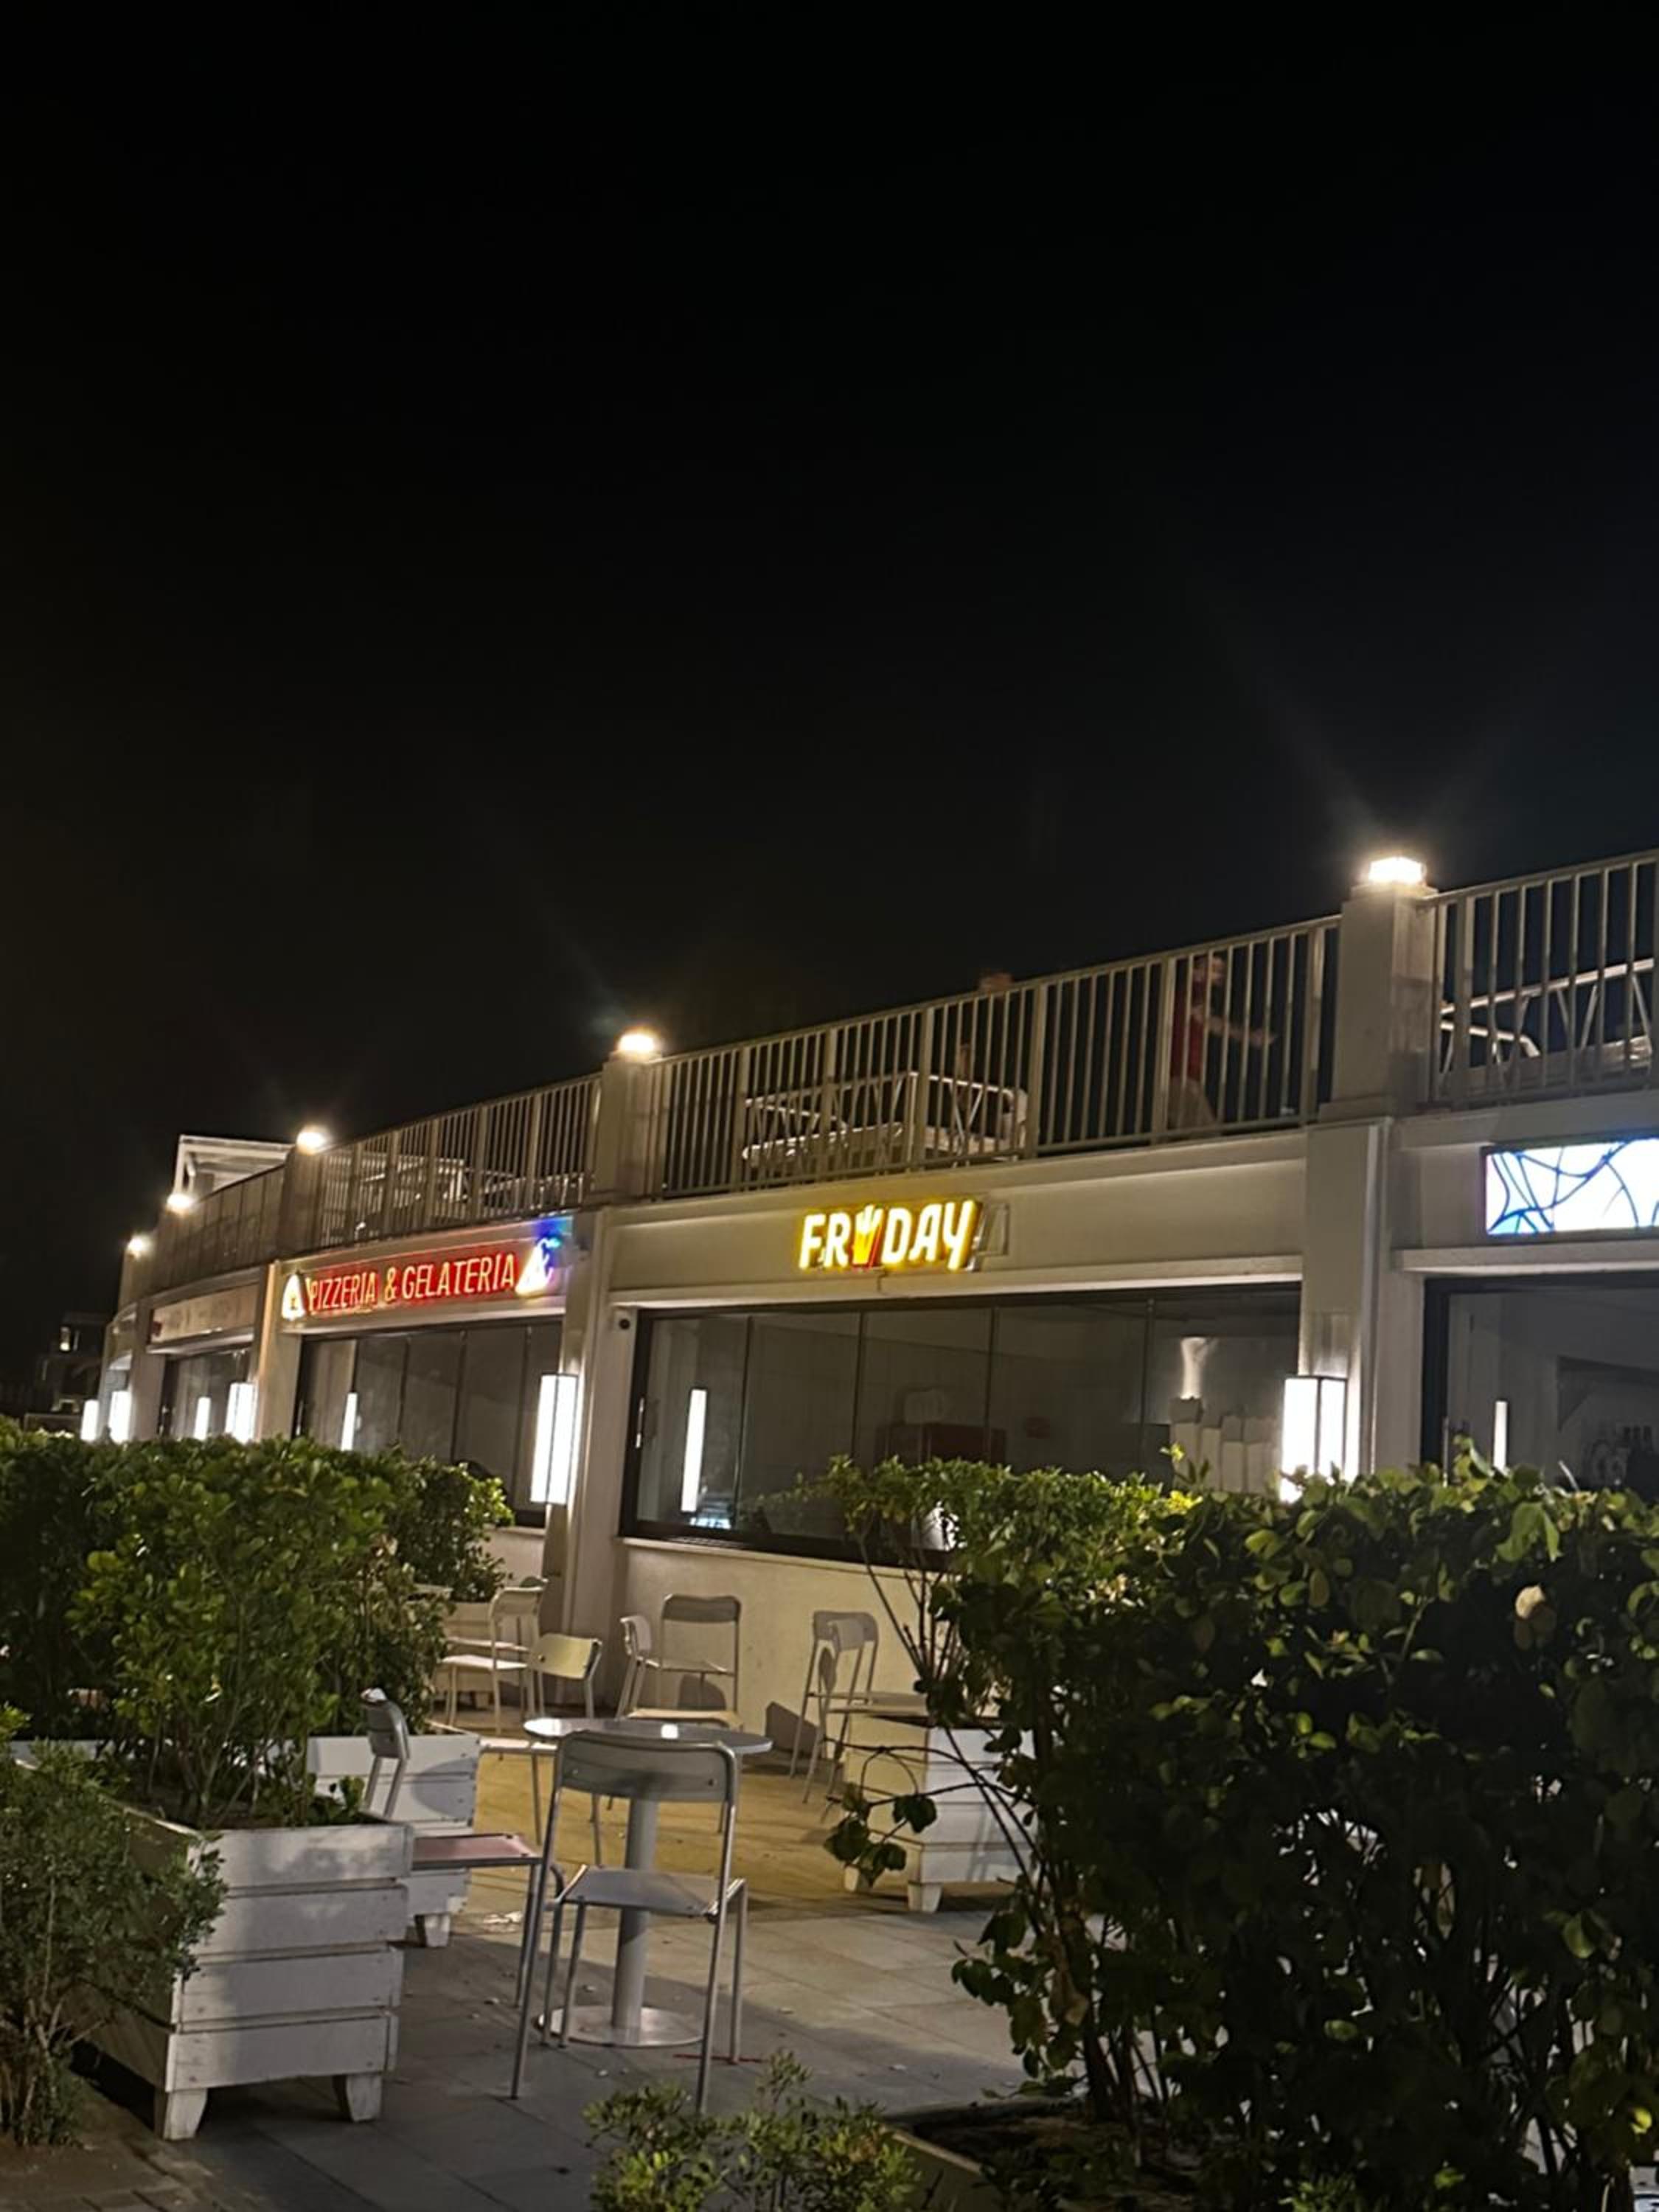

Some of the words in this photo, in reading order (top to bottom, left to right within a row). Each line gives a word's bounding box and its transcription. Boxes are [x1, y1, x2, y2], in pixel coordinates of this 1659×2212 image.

[307, 1272, 378, 1311] PIZZERIA
[384, 1267, 400, 1302] &
[401, 1253, 515, 1300] GELATERIA
